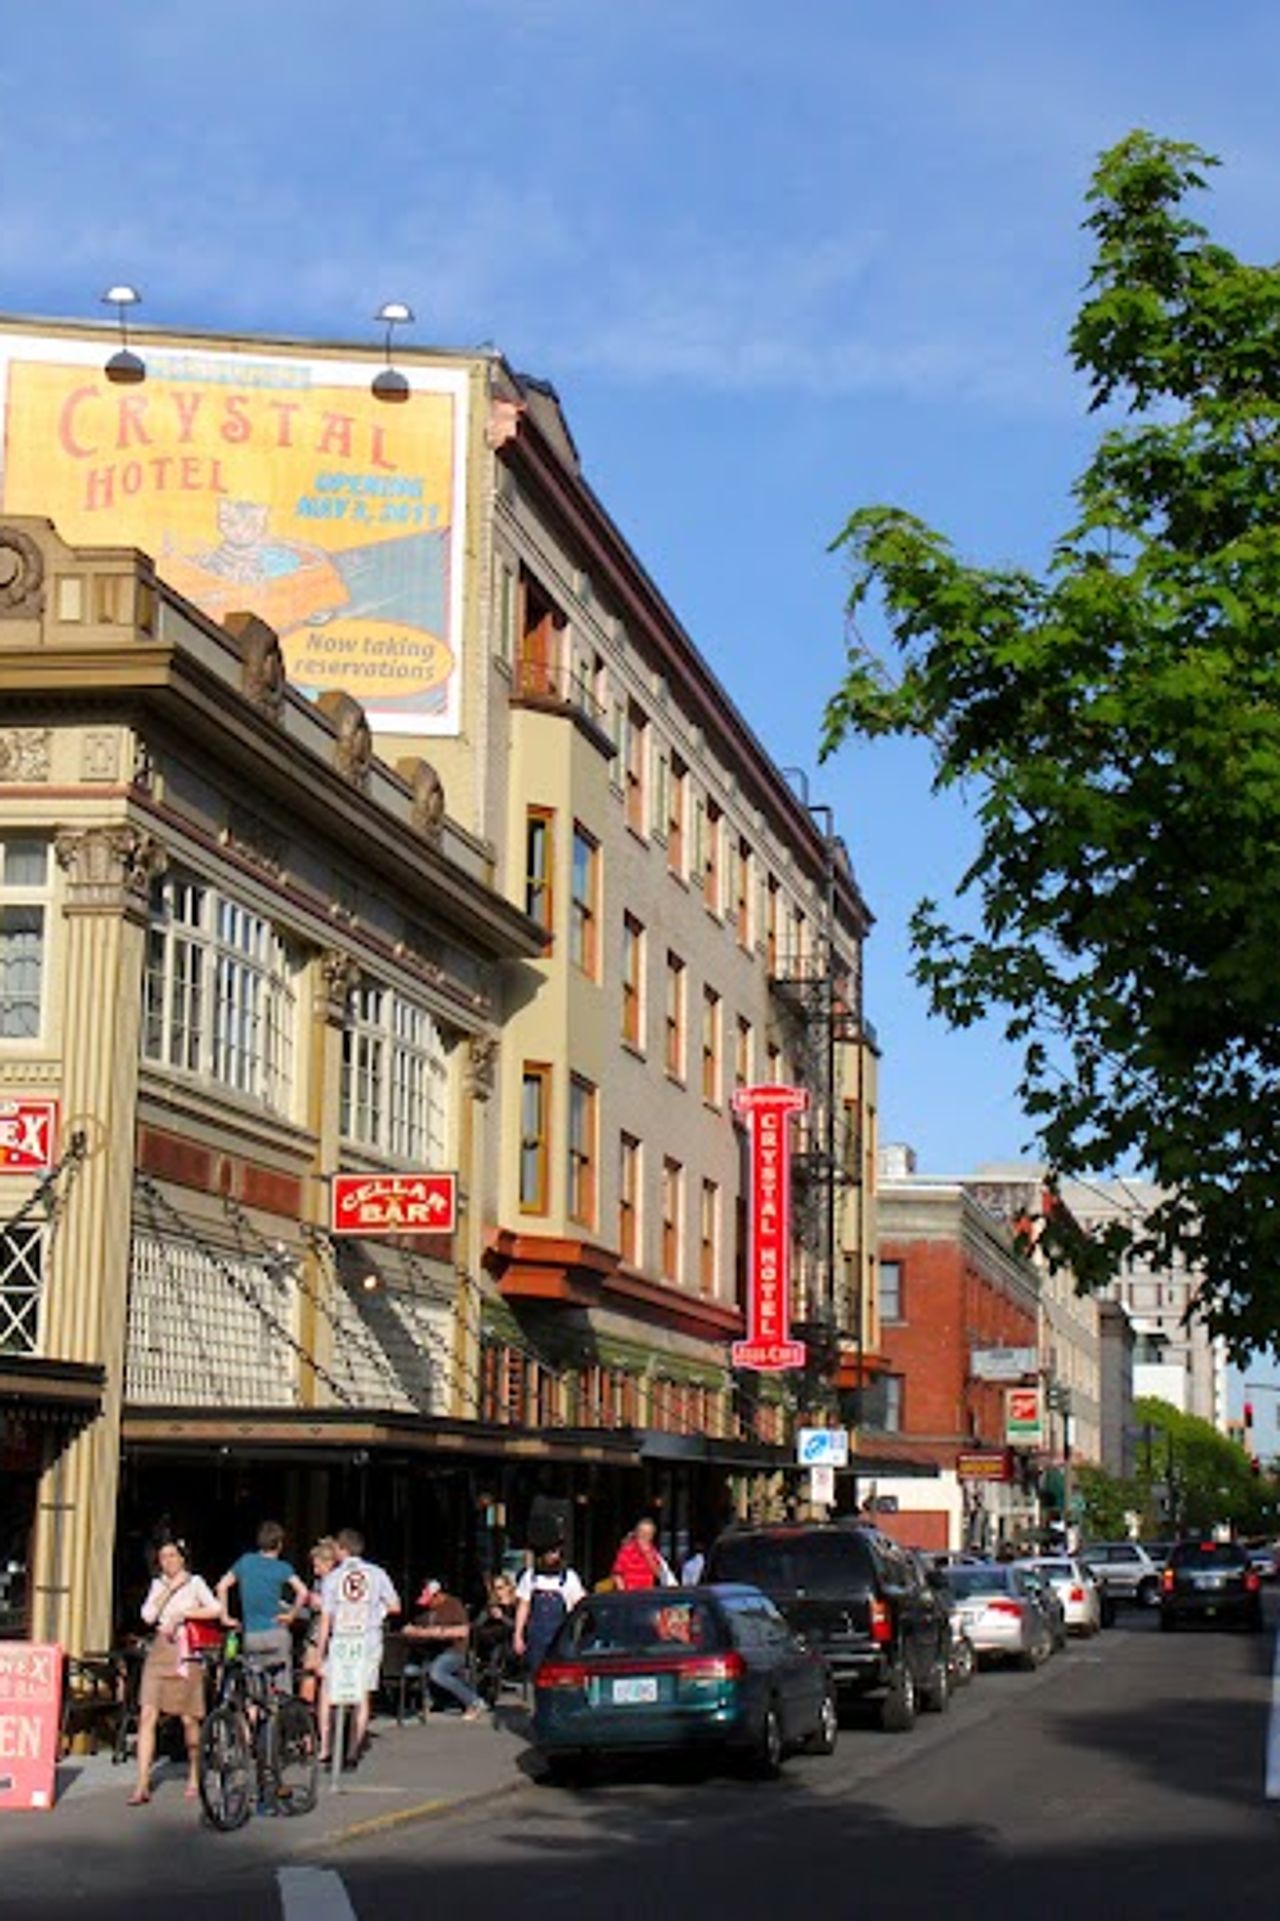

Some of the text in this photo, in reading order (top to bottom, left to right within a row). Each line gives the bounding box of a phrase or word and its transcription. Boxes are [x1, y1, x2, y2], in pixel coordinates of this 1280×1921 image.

[58, 385, 398, 472] CRYSTAL
[83, 456, 230, 512] HOTEL
[306, 632, 435, 663] Now taking
[293, 658, 435, 681] reservations
[341, 1181, 448, 1214] CELLAR
[359, 1203, 431, 1223] BAR
[760, 1112, 778, 1335] CRYSTAL HOTEL
